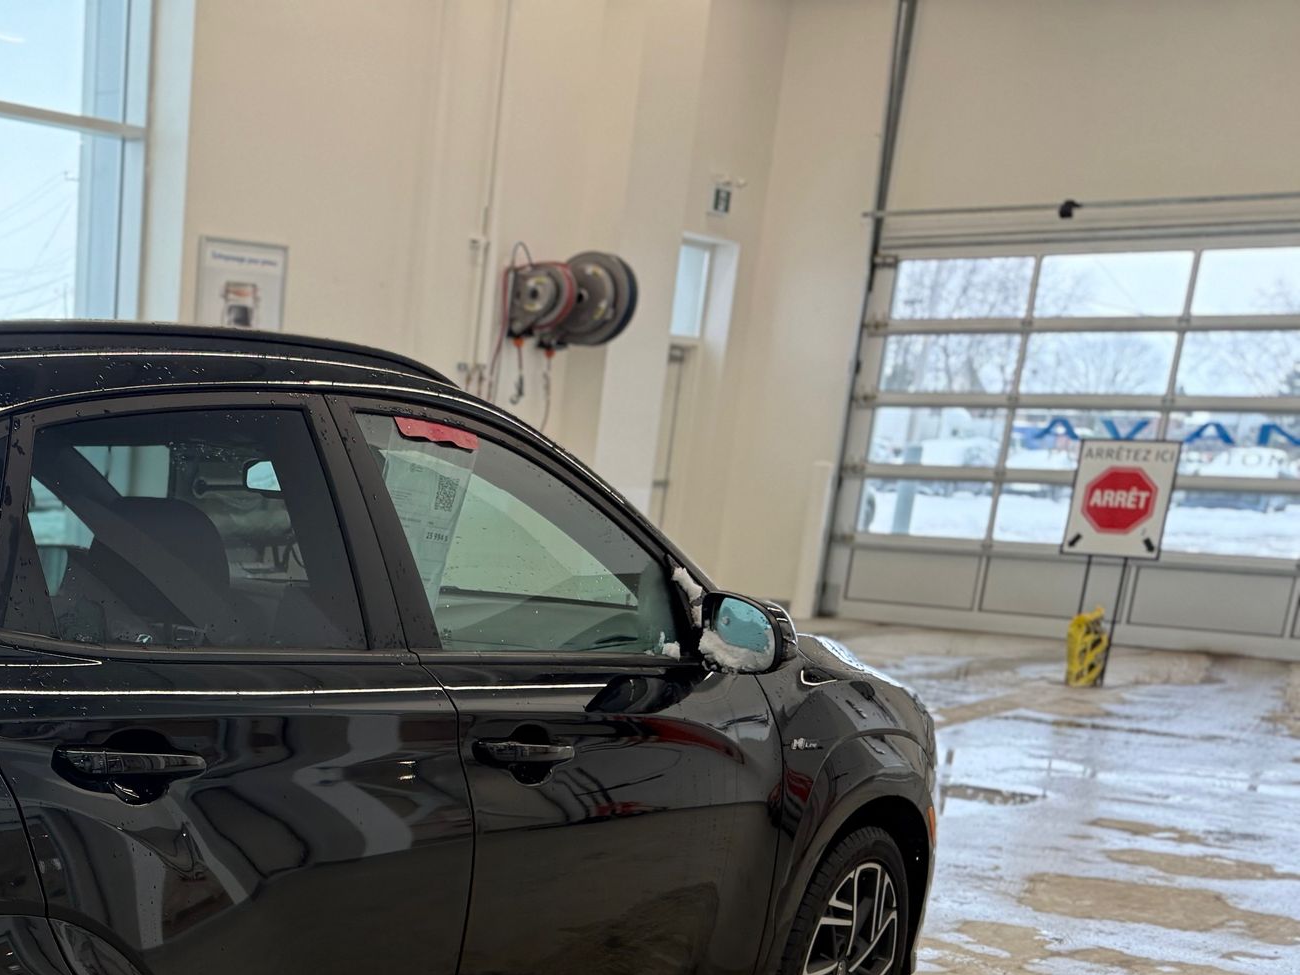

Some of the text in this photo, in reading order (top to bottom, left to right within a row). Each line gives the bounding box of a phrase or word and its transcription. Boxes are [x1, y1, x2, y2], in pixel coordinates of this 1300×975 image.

[1084, 446, 1151, 462] ARRÊTEZ
[1154, 448, 1175, 463] ICI
[1089, 487, 1150, 509] ARRÊT
